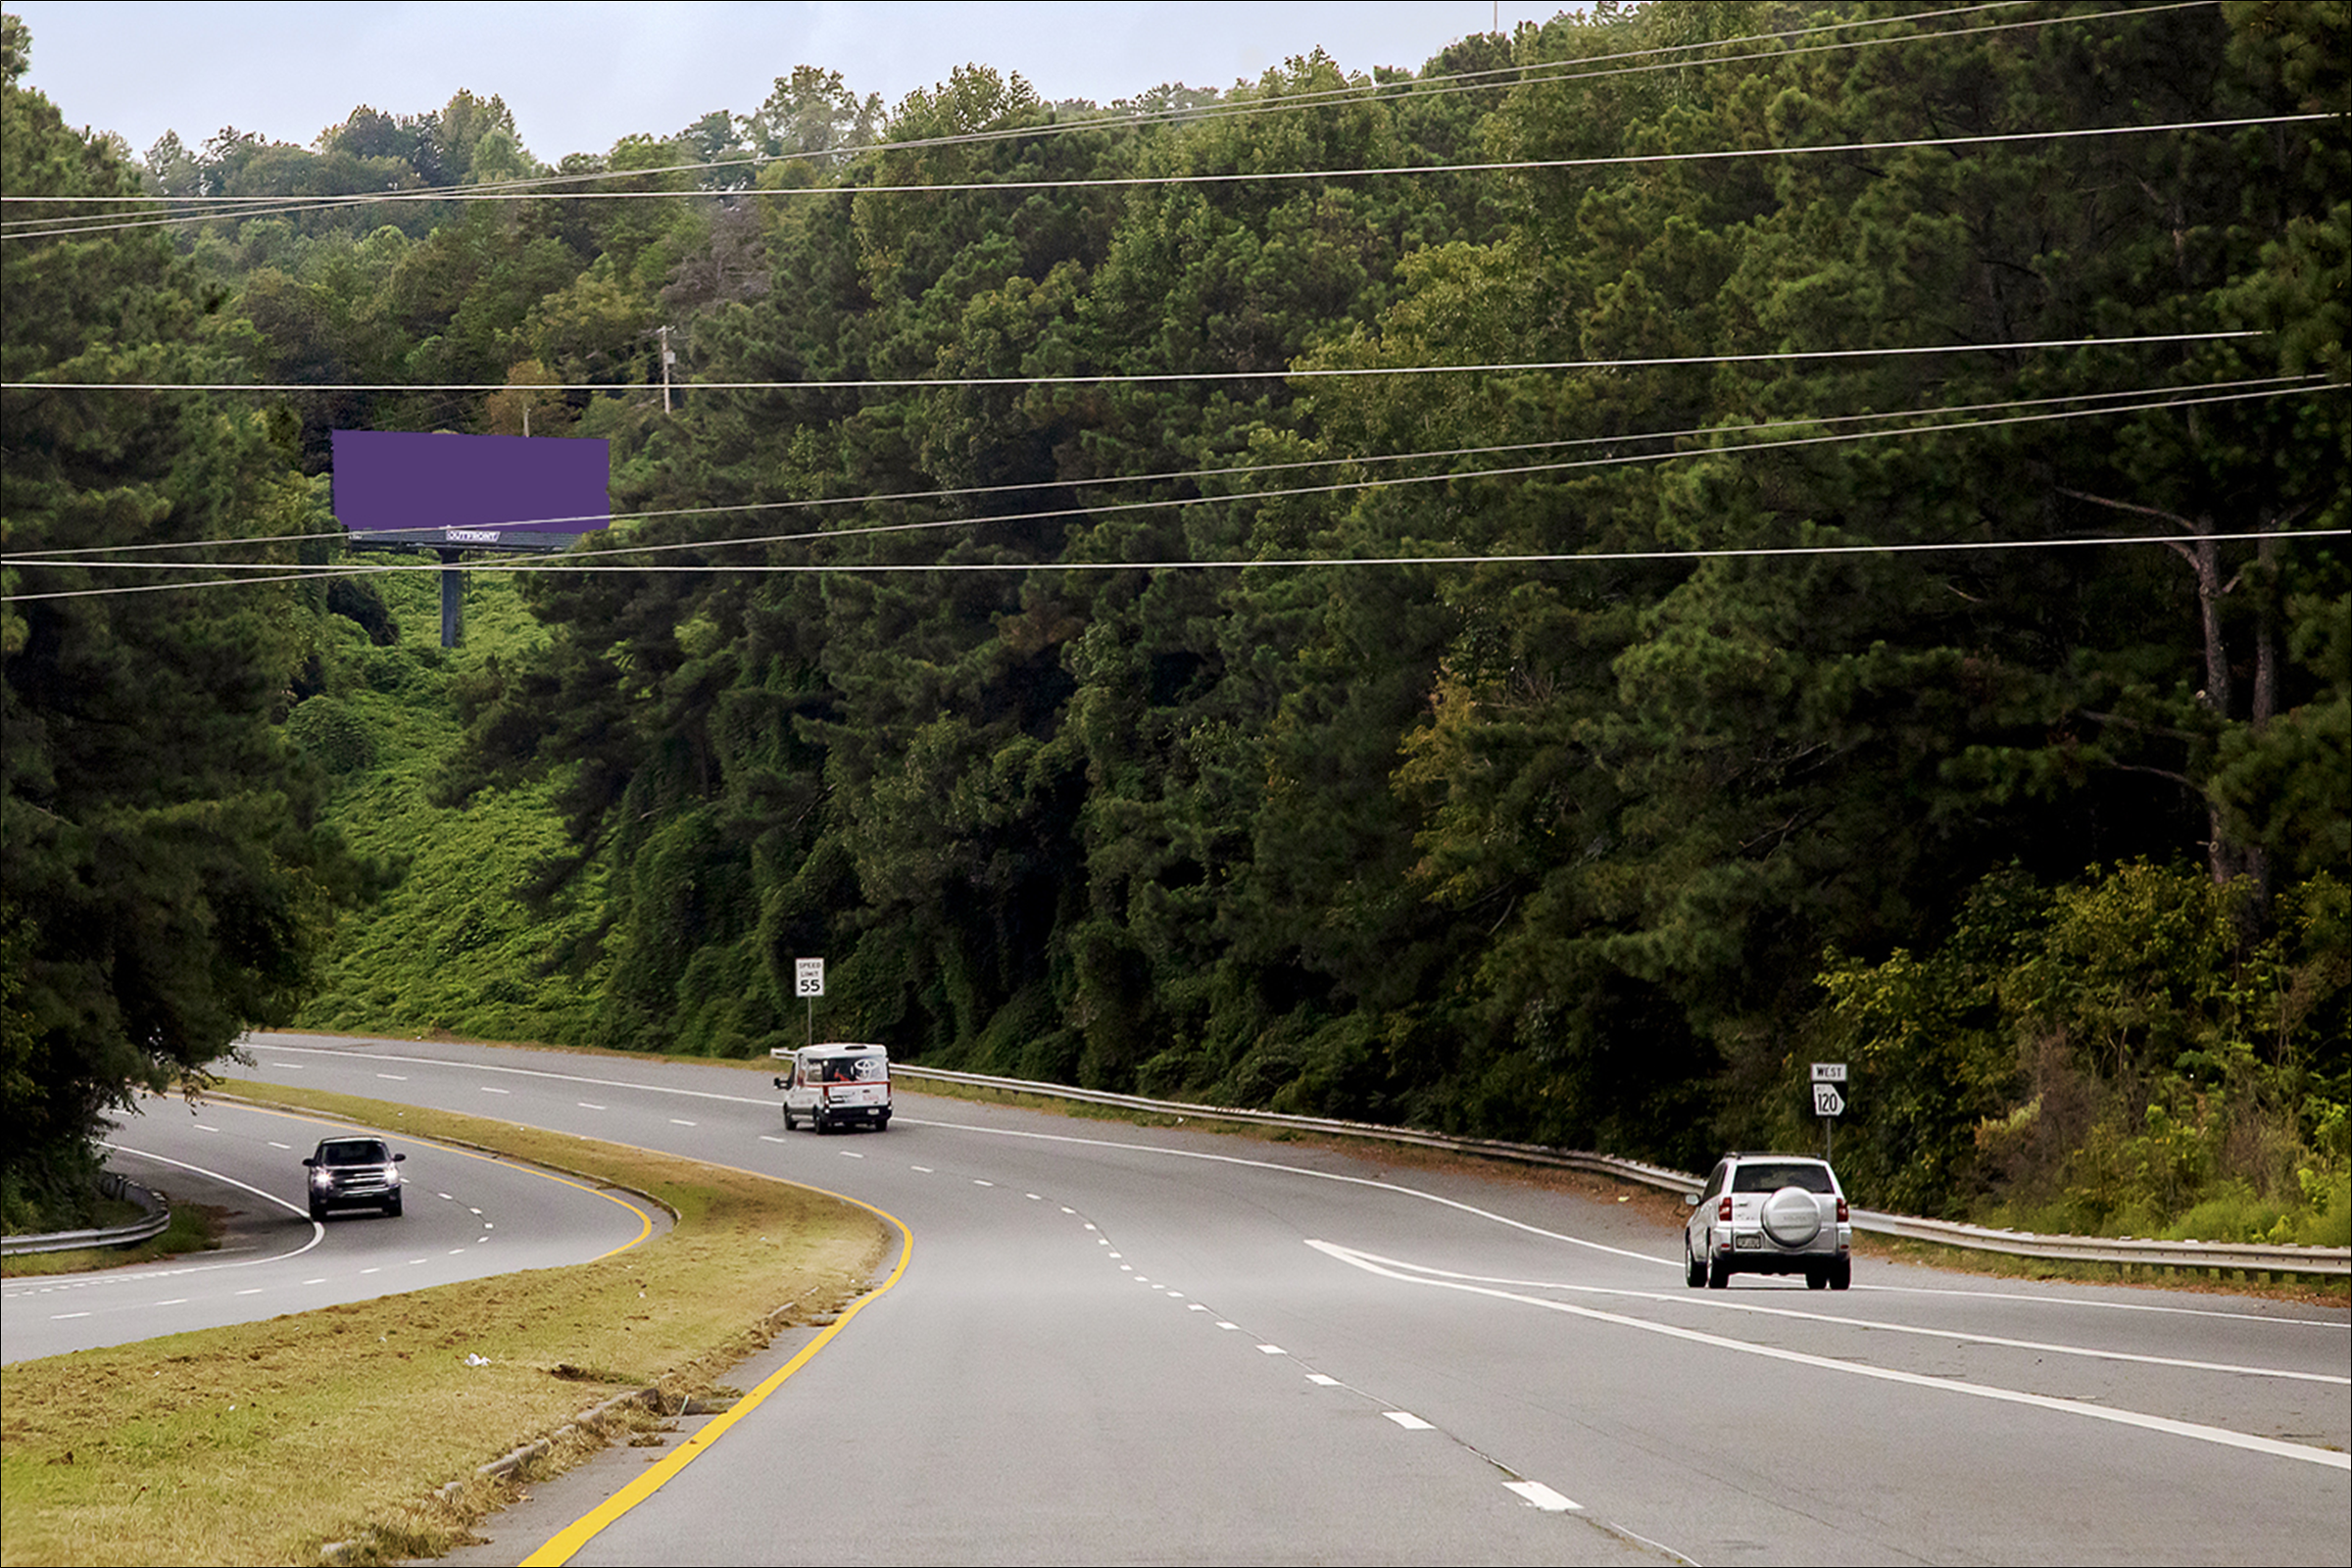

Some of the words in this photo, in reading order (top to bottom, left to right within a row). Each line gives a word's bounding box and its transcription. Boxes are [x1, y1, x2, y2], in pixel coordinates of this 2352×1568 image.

[801, 979, 820, 992] 55
[1816, 1067, 1841, 1077] WEST
[1818, 1093, 1838, 1112] 120
